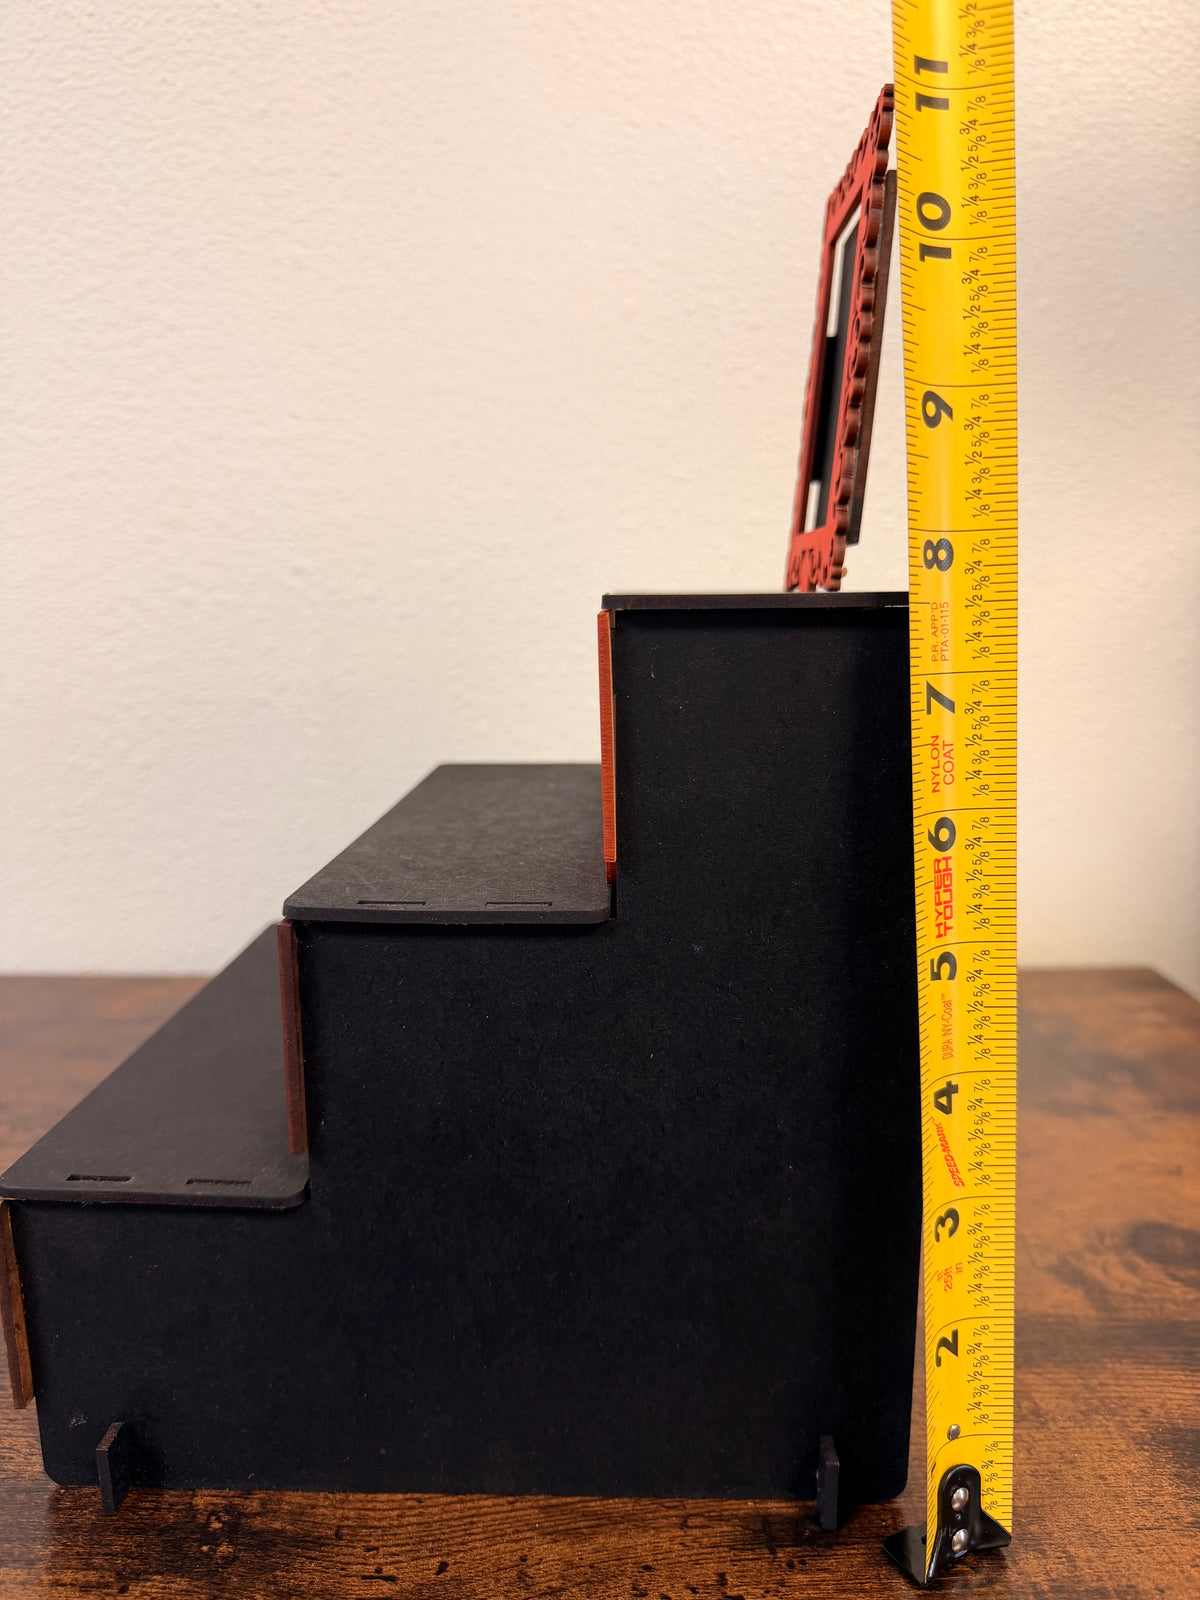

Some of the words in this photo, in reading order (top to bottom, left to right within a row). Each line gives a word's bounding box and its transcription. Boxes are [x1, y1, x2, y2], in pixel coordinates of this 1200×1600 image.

[914, 55, 949, 112] 11
[916, 192, 952, 262] 10
[922, 391, 953, 428] 9
[923, 538, 954, 572] 8
[926, 680, 955, 715] 7
[931, 735, 939, 793] NYLON
[943, 741, 954, 785] COAT
[928, 817, 956, 852] 6
[934, 858, 943, 938] HYPER
[942, 856, 953, 936] TOUGH
[930, 952, 957, 981] 5
[933, 1081, 958, 1115] 4
[934, 1208, 959, 1242] 3
[935, 1329, 958, 1367] 2
